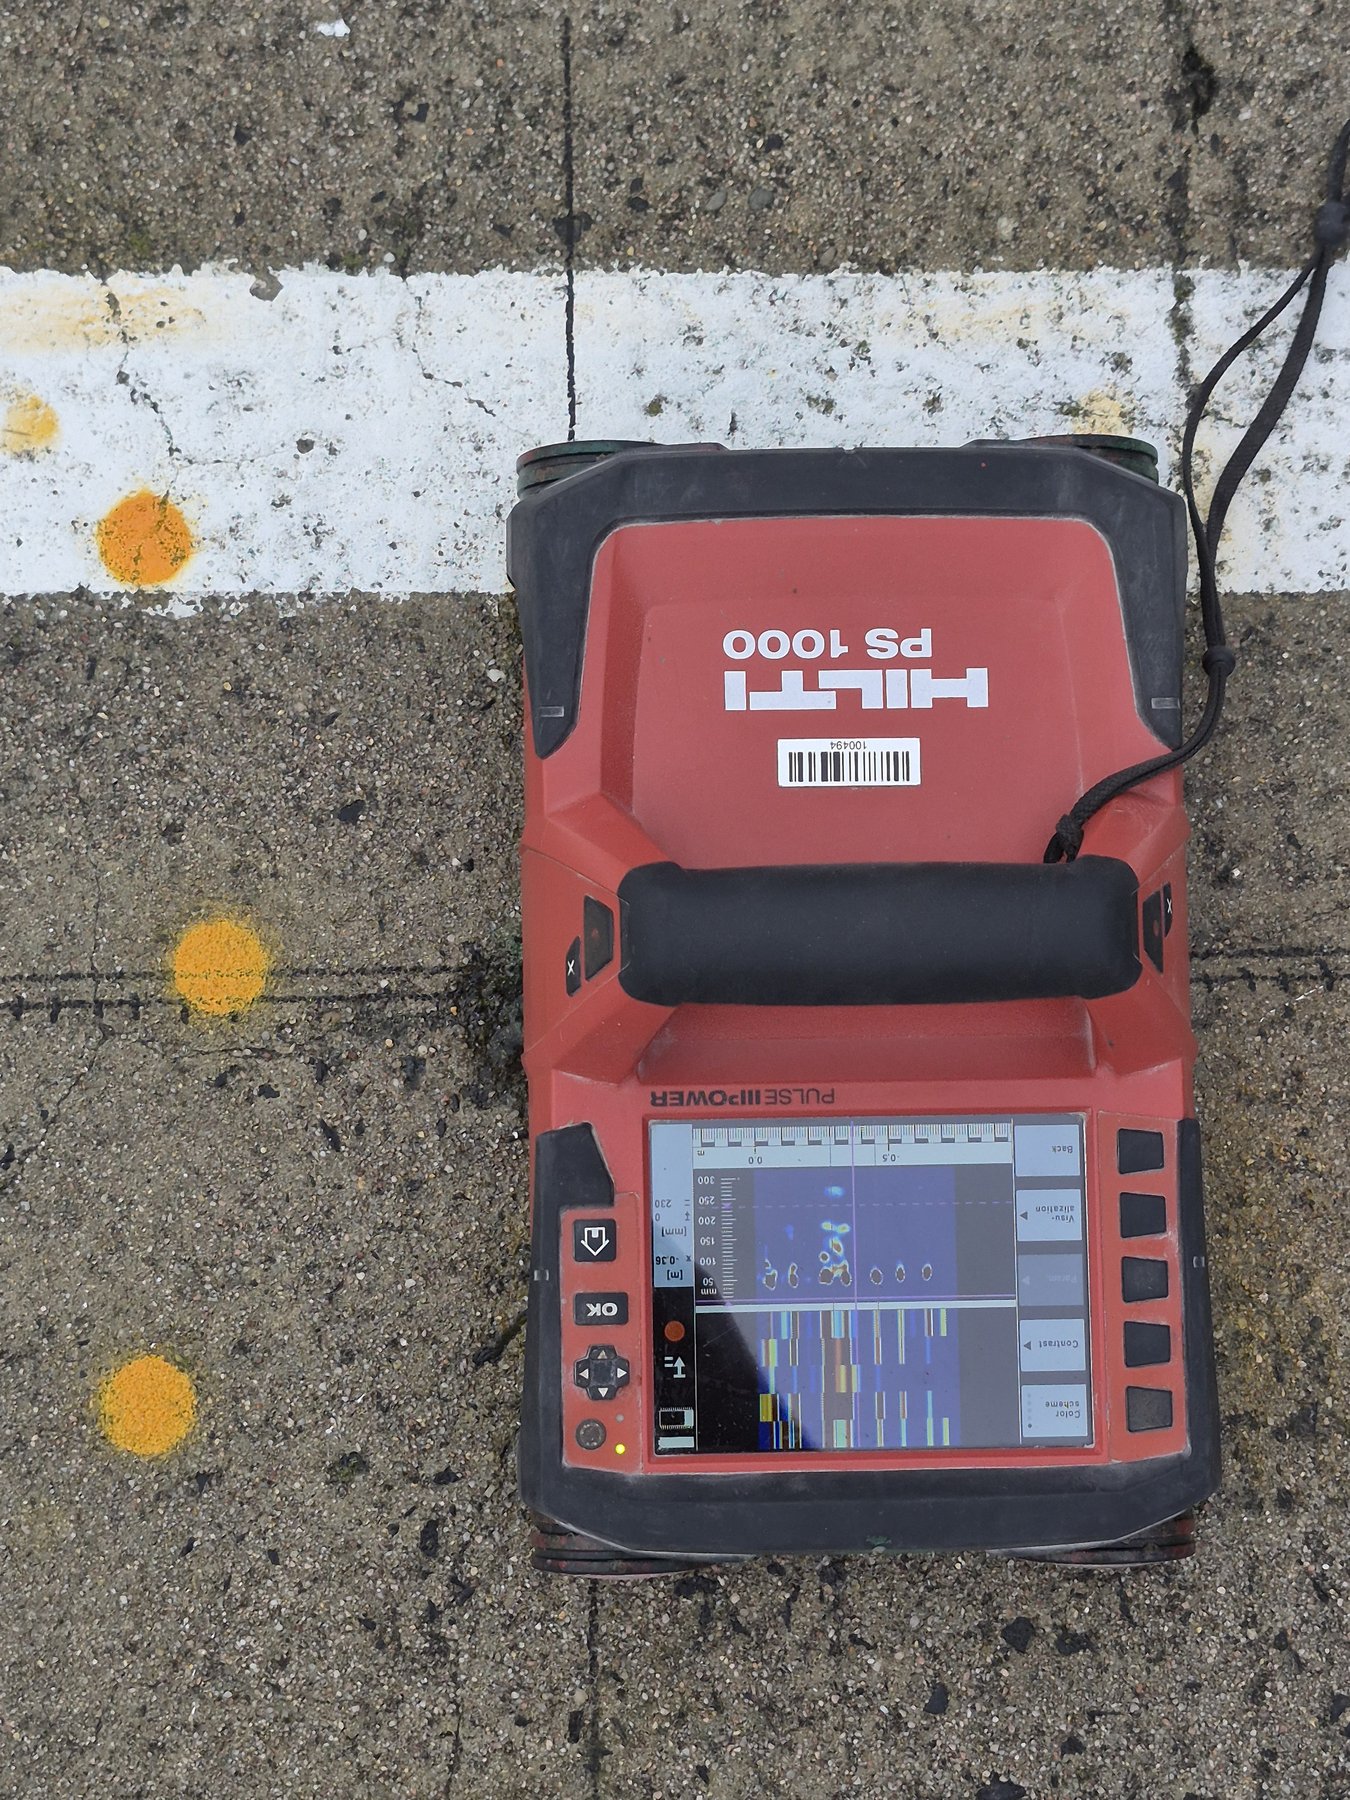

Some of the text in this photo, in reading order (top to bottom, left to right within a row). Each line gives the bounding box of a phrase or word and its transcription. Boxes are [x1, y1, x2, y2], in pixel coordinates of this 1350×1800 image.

[722, 628, 933, 660] PS 1000
[724, 667, 989, 711] HILTI
[830, 740, 867, 751] 100494
[1051, 1145, 1074, 1154] Back
[697, 1176, 715, 1185] 300
[654, 1200, 672, 1209] 230
[698, 1196, 715, 1205] 250
[1035, 1205, 1075, 1215] alization
[654, 1213, 661, 1222] 0
[698, 1216, 716, 1225] 200
[1051, 1214, 1075, 1223] Visu-
[699, 1236, 715, 1246] 150
[655, 1255, 679, 1266] -0.36
[699, 1257, 716, 1266] 100
[702, 1277, 714, 1286] 50
[700, 1287, 717, 1295] mm
[585, 1302, 618, 1317] OK
[1039, 1339, 1079, 1349] Contrast
[1045, 1400, 1080, 1409] scheme
[1055, 1410, 1081, 1419] Color
